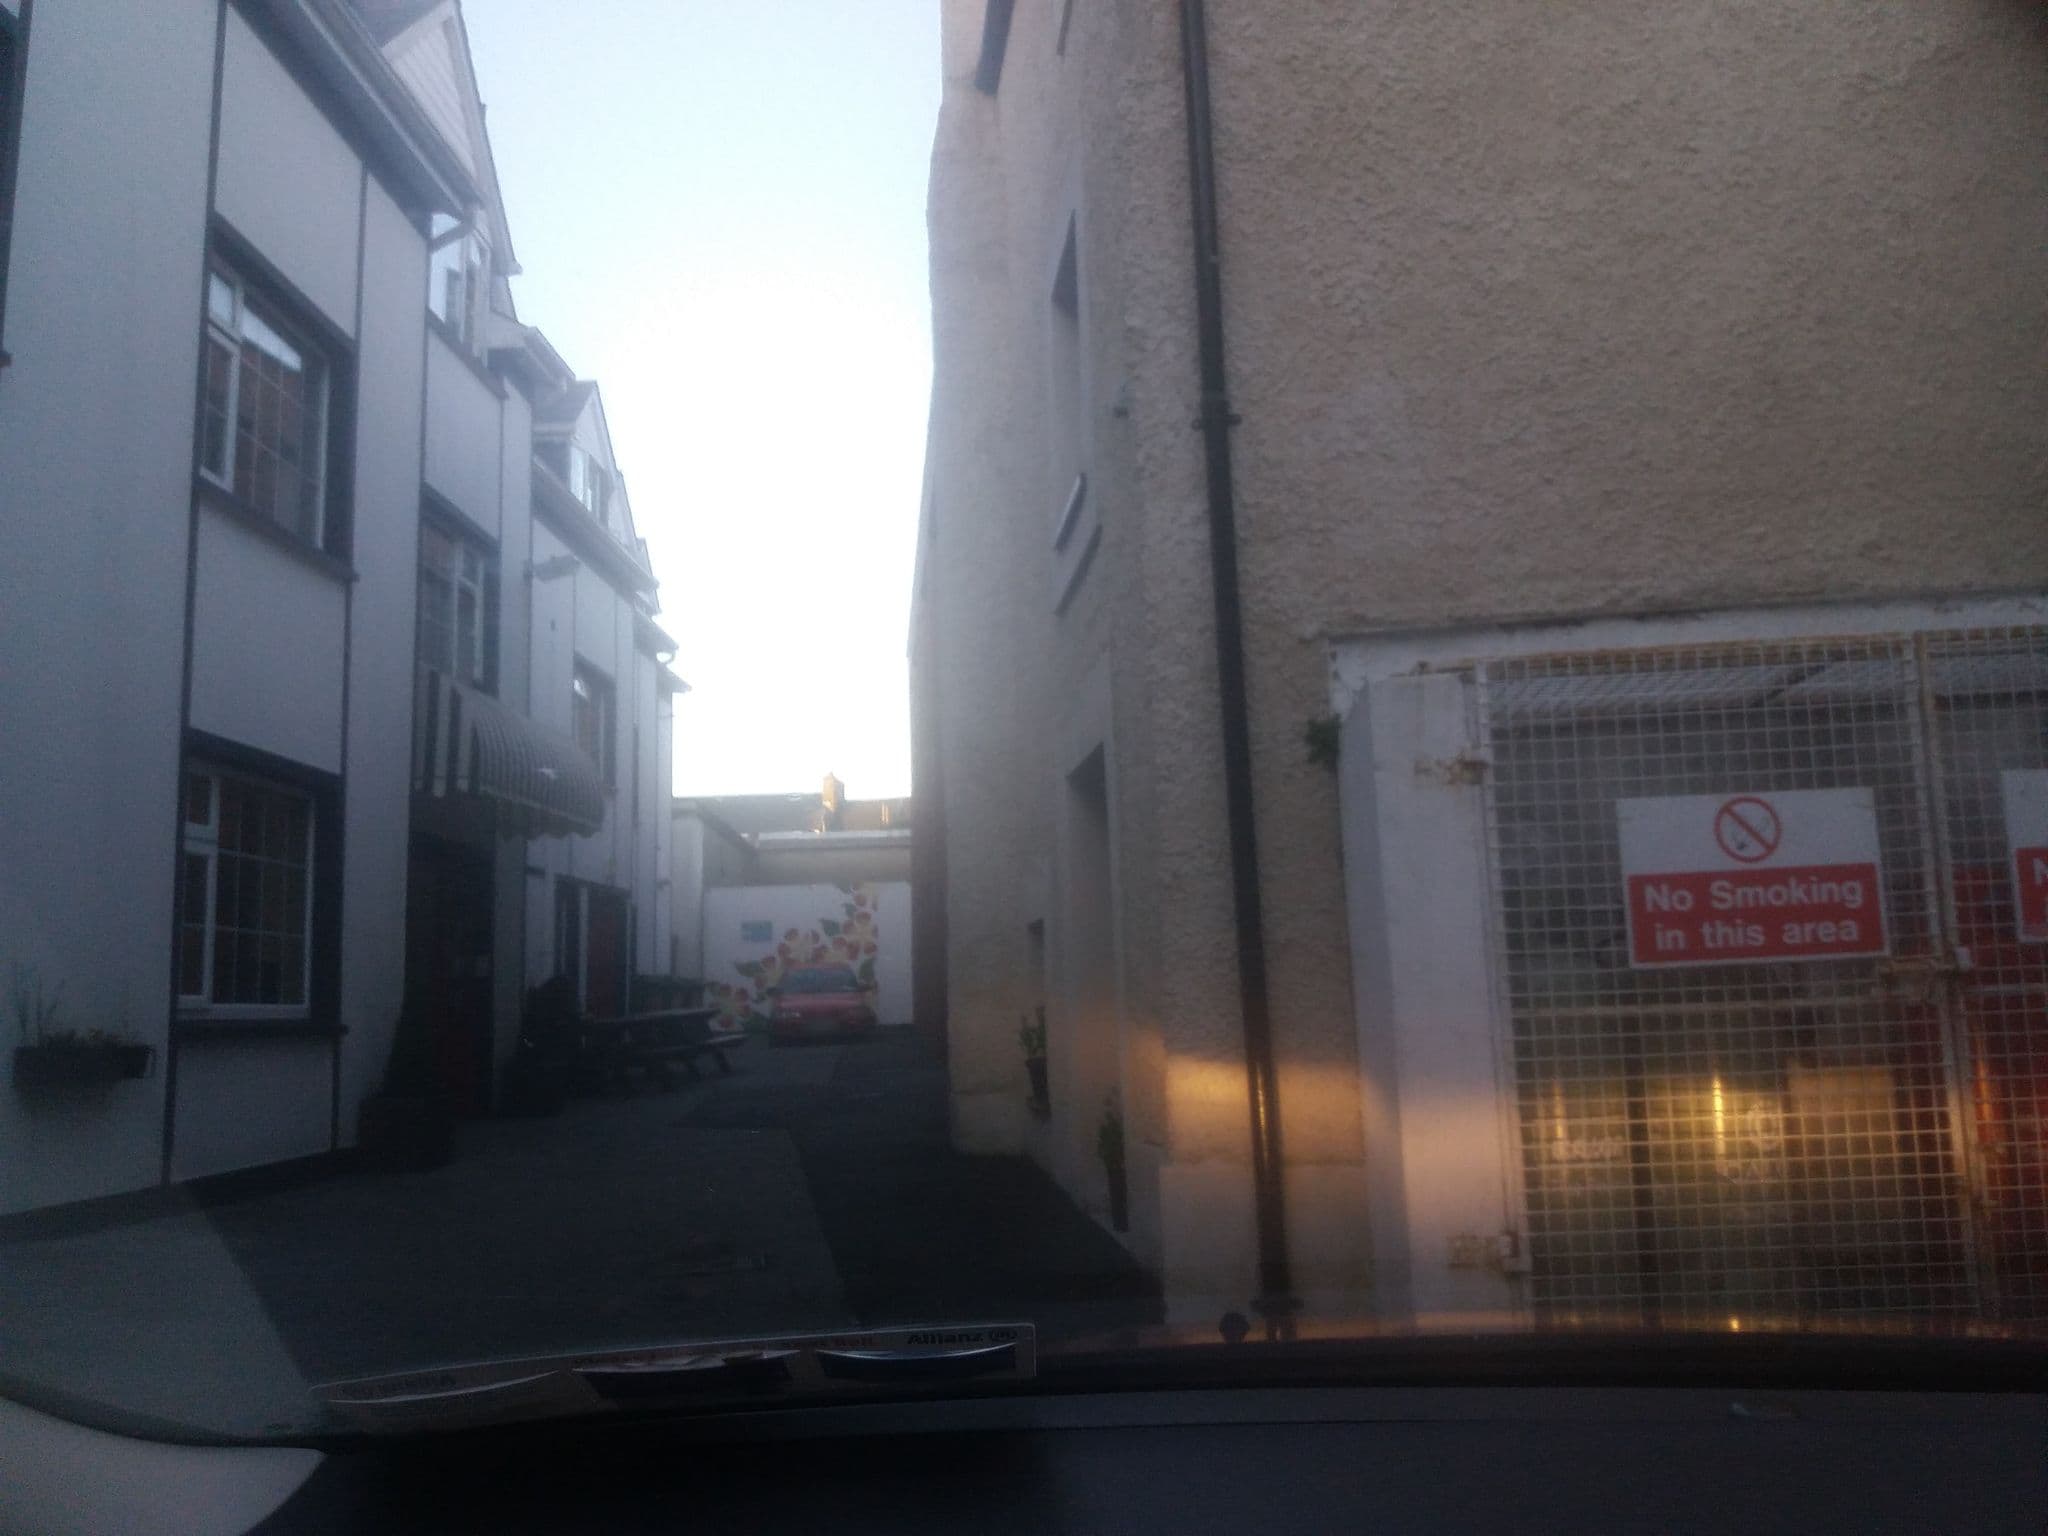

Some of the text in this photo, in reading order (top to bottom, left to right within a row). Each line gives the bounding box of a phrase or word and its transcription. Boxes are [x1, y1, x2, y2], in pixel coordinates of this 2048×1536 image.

[1644, 875, 1865, 913] No Smoking
[1655, 919, 1860, 951] in this area
[907, 1330, 984, 1345] Allianz
